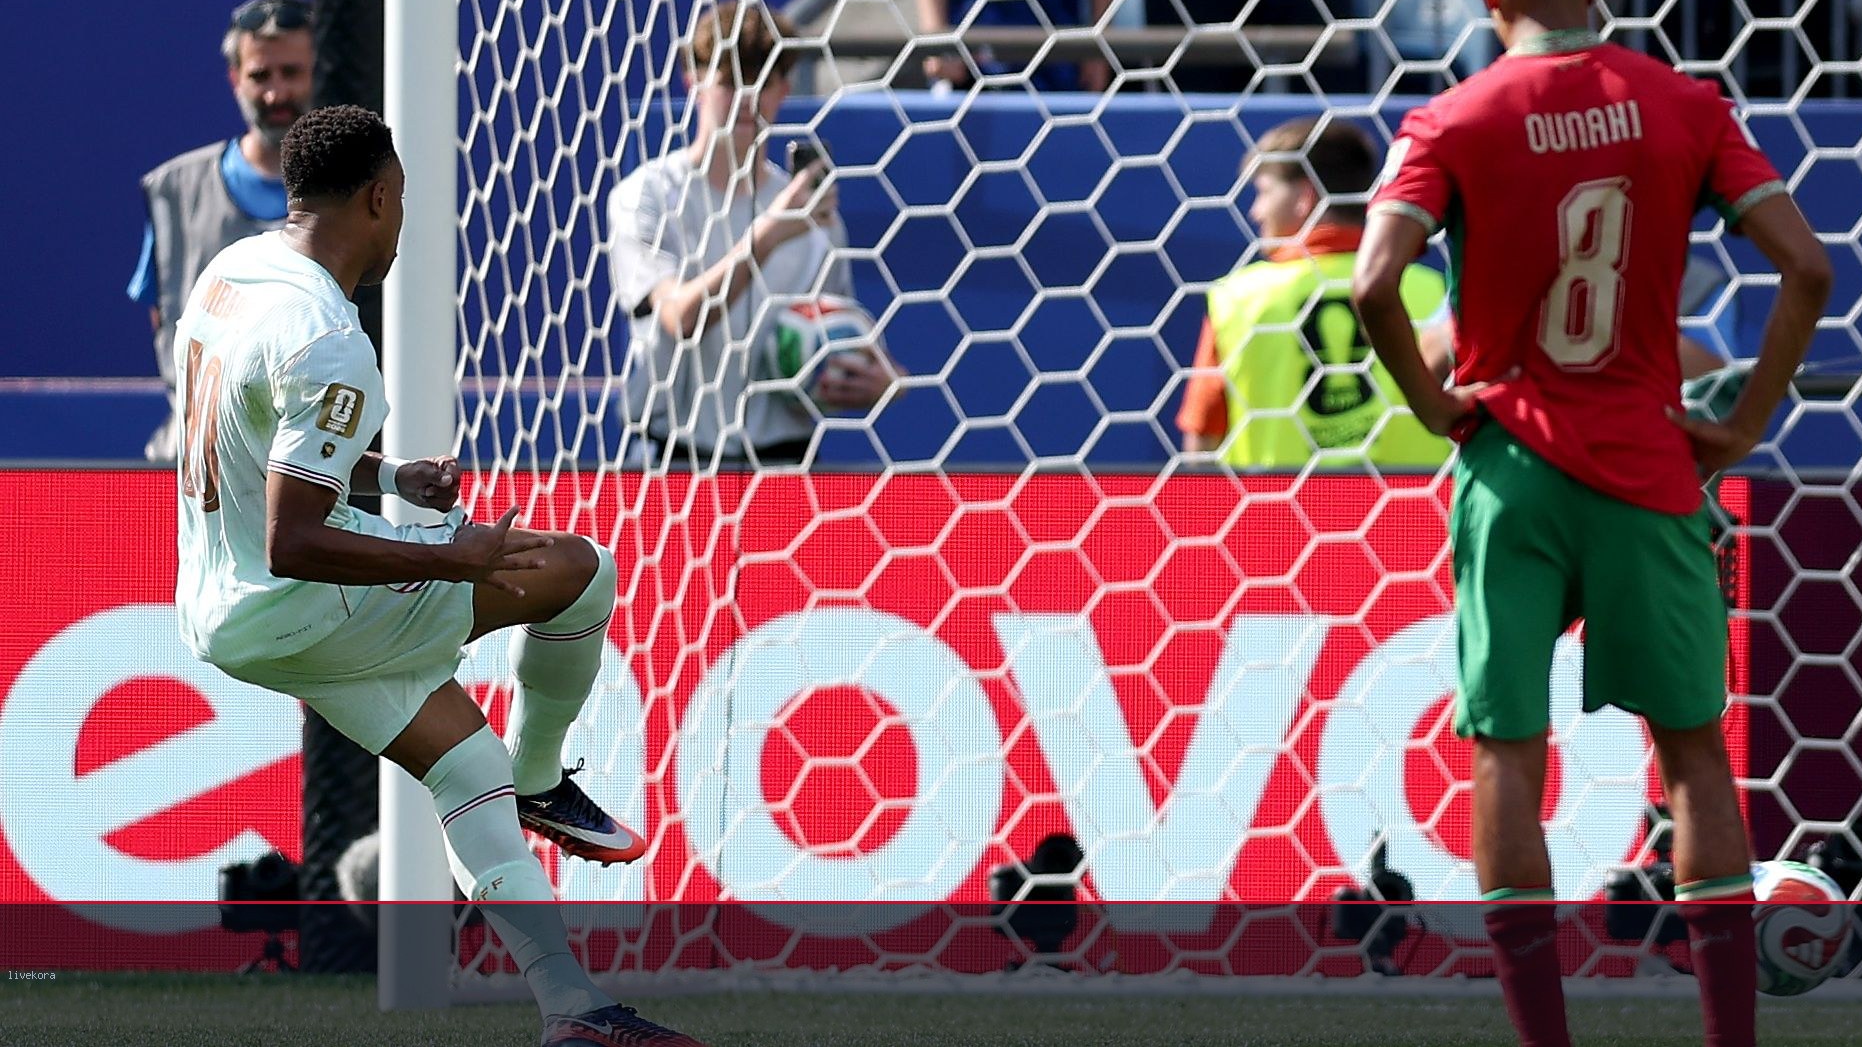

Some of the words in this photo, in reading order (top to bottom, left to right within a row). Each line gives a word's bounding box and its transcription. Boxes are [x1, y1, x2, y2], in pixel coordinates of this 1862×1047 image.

[1525, 100, 1643, 154] OUNAHI
[1536, 175, 1634, 373] 8
[182, 336, 222, 513] 10
